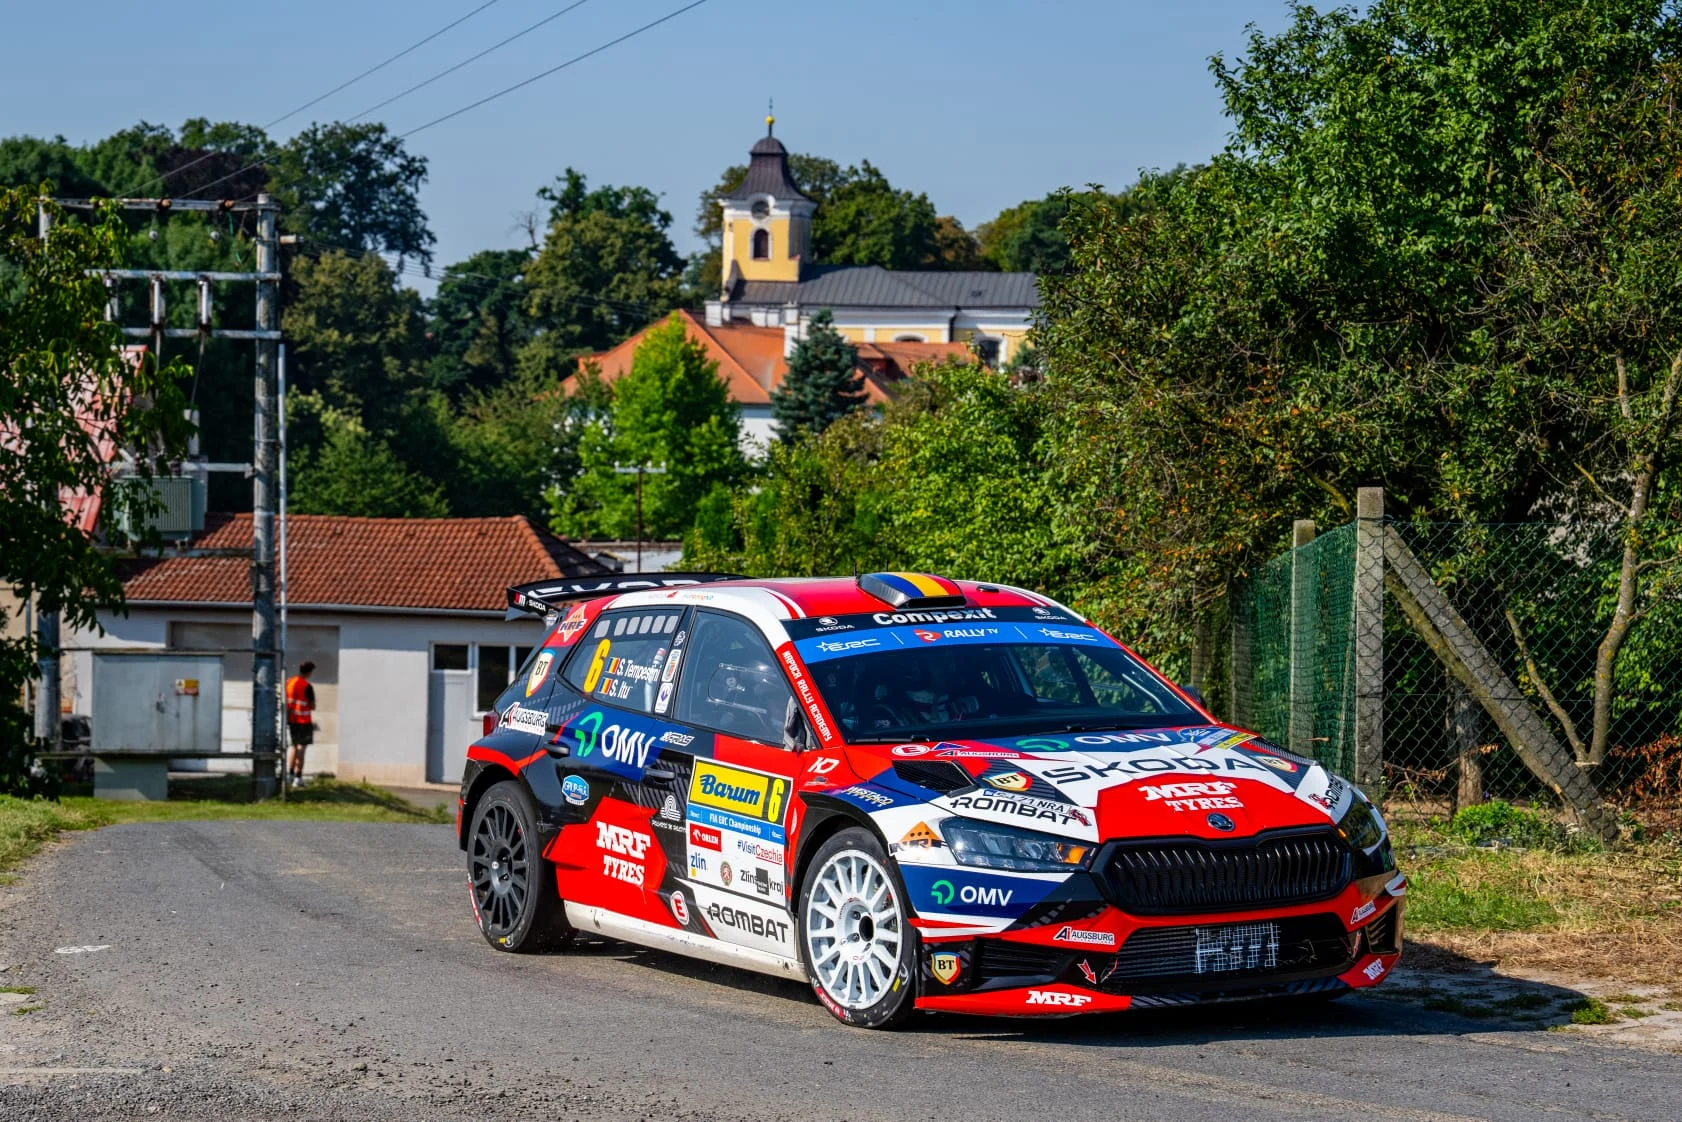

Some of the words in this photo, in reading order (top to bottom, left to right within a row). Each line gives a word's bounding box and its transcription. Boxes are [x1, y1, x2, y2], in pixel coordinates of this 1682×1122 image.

[873, 607, 997, 625] Compexit
[943, 628, 986, 639] RALLY
[534, 661, 549, 677] BT
[583, 638, 611, 693] 6
[797, 679, 814, 704] RALLY
[809, 703, 833, 742] ACADEMY
[601, 725, 656, 769] OMV
[1074, 731, 1172, 746] OMV
[998, 773, 1021, 786] BT
[699, 773, 761, 806] Barum
[767, 778, 785, 823] 6
[1138, 781, 1239, 801] MRF
[949, 797, 1076, 826] ROMBAT
[1036, 800, 1064, 813] NRA
[1165, 797, 1244, 812] TYRES
[729, 818, 762, 835] Championship
[596, 820, 651, 860] MRF
[701, 833, 719, 845] ORLEN
[603, 855, 645, 885] TYRES
[960, 885, 1013, 907] OMV
[674, 901, 684, 918] E
[706, 902, 789, 944] ROMBAT
[1071, 931, 1113, 942] AUGSBURG
[937, 959, 955, 970] BT
[1025, 990, 1092, 1007] MRF
